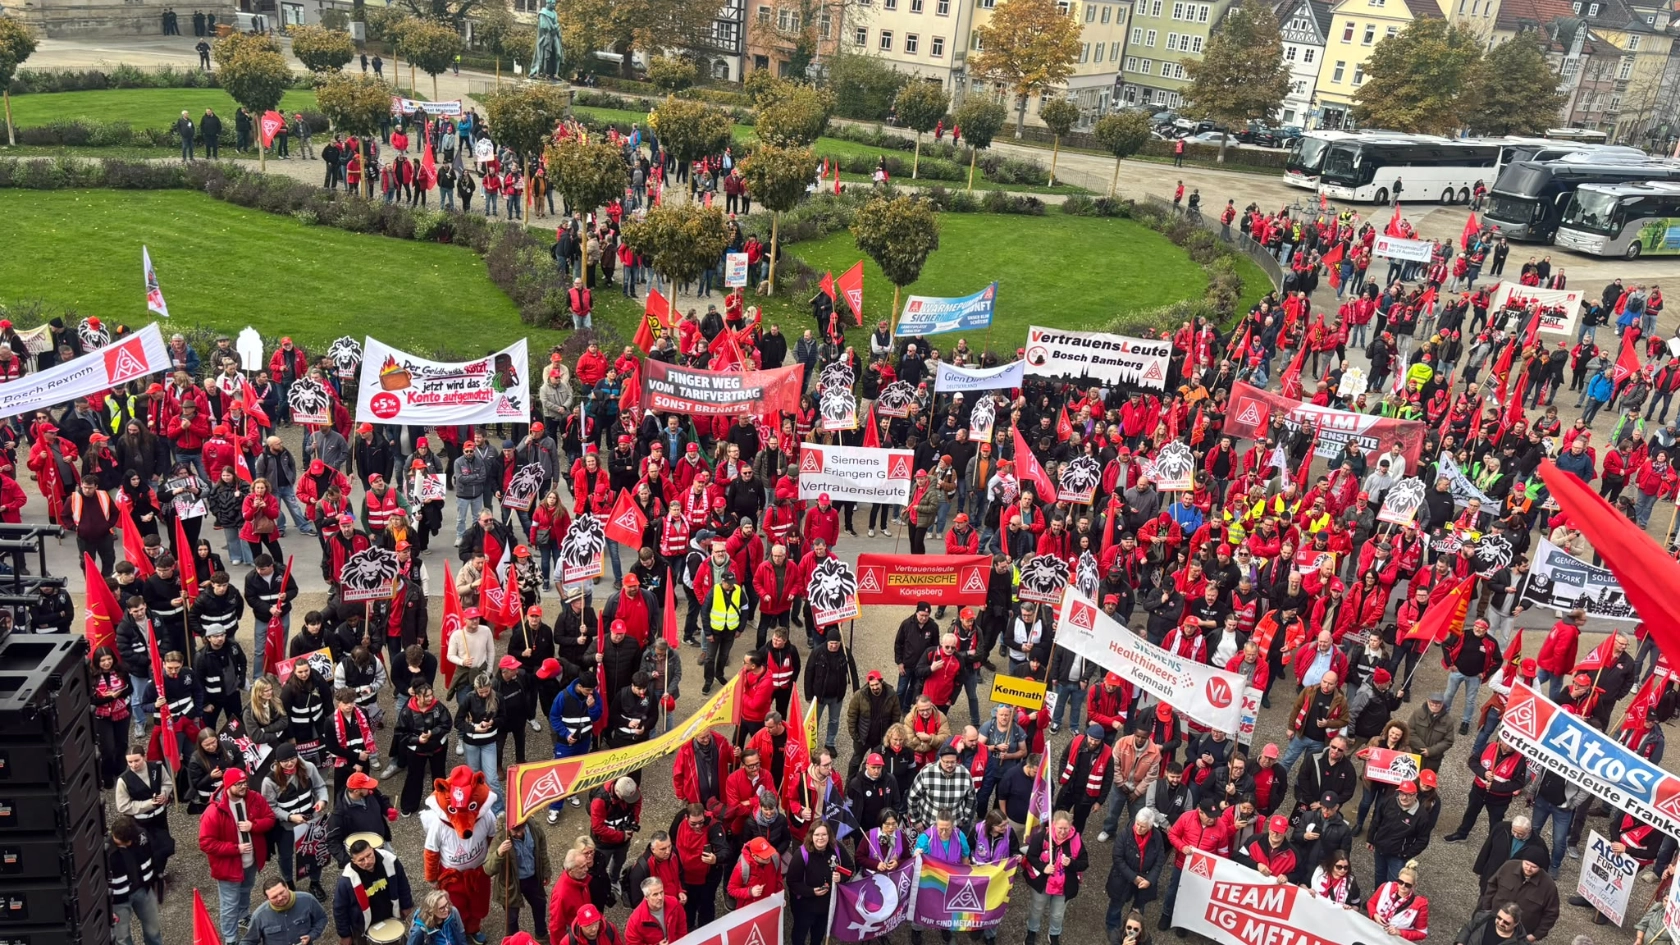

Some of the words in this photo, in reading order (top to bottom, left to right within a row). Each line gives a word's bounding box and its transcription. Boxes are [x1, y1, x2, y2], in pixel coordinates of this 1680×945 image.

[402, 359, 421, 373] Der
[1052, 350, 1088, 362] Bosch
[1091, 355, 1144, 371] Bamberg
[47, 366, 94, 390] Rexroth
[421, 380, 445, 394] jetzt
[446, 379, 464, 390] wird
[466, 378, 481, 389] das
[667, 370, 710, 388] FINGER
[712, 377, 740, 389] WEG
[3, 386, 44, 404] Bosch
[407, 391, 441, 405] Konto
[443, 388, 494, 405] aufgemotzt!
[648, 379, 674, 394] VOM
[679, 386, 761, 402] TARIFVERTRAG
[654, 396, 692, 411] SONST
[1293, 409, 1356, 430] TEAM
[831, 455, 880, 466] Siemens
[824, 467, 873, 480] Erlangen
[876, 470, 886, 479] G
[801, 481, 906, 497] Vertrauensleute
[894, 564, 955, 573] Vertrauensleute
[888, 573, 957, 585] FRÄNKISCHE
[1554, 572, 1581, 584] STARK
[1592, 573, 1620, 584] SOLID
[899, 587, 943, 597] Königsberg
[1108, 640, 1178, 686] Healthineers
[1133, 640, 1182, 673] SIEMENS
[1130, 665, 1174, 698] Kemnath
[994, 684, 1042, 701] Kemnath
[1208, 678, 1230, 704] VL
[1549, 723, 1655, 794] Atos
[1590, 837, 1636, 877] Atos
[1599, 886, 1618, 907] Tarif
[1604, 882, 1619, 896] IT
[1216, 883, 1287, 914] TEAM
[1578, 883, 1623, 924] EVIDEN
[920, 914, 934, 926] WIR
[936, 918, 953, 928] SIND
[1209, 905, 1238, 930] IG
